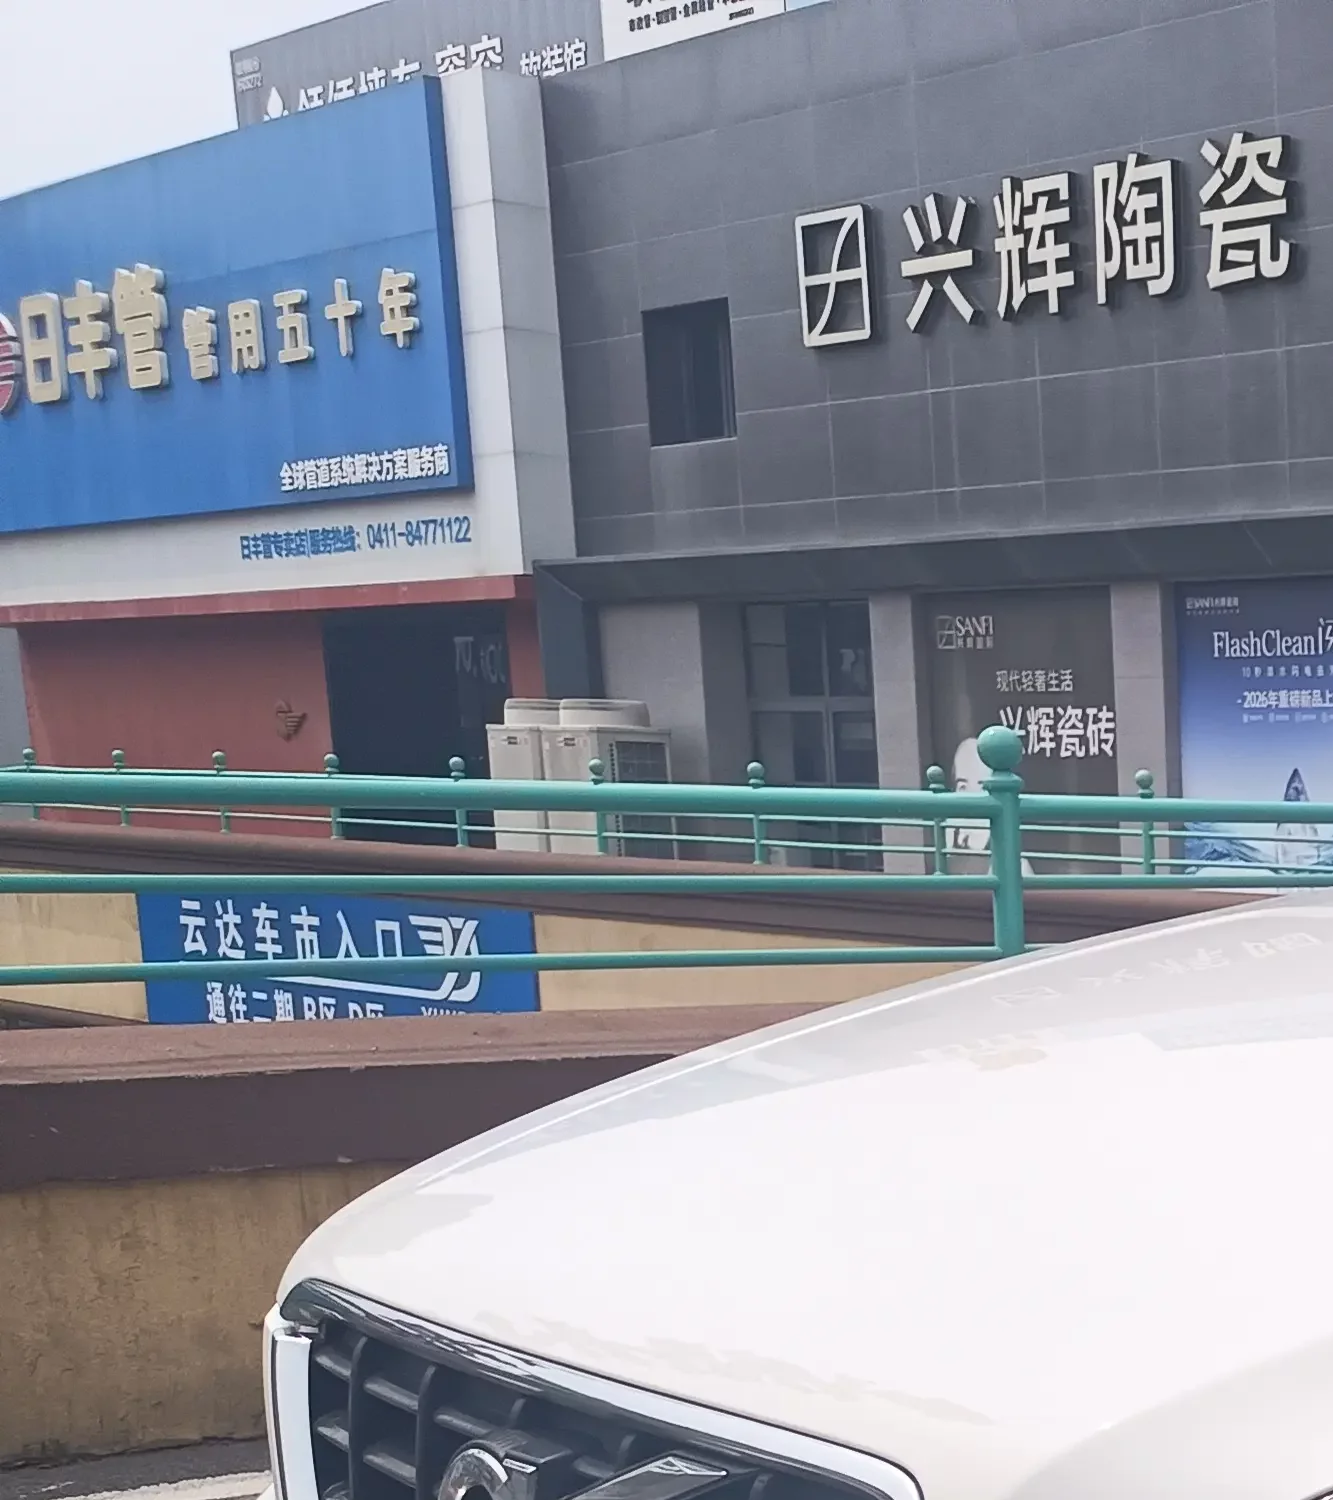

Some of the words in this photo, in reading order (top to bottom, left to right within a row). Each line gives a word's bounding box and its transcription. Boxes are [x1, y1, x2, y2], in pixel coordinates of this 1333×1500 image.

[901, 131, 1293, 334] 兴辉陶瓷
[20, 263, 171, 406] 日丰管
[183, 267, 423, 382] 管用五十年
[279, 443, 450, 492] 全球管道系统解决方案服务商
[366, 515, 472, 550] 0411-84771122
[996, 669, 1074, 692] 现代轻奢生活
[179, 899, 403, 960] 云达车市入口
